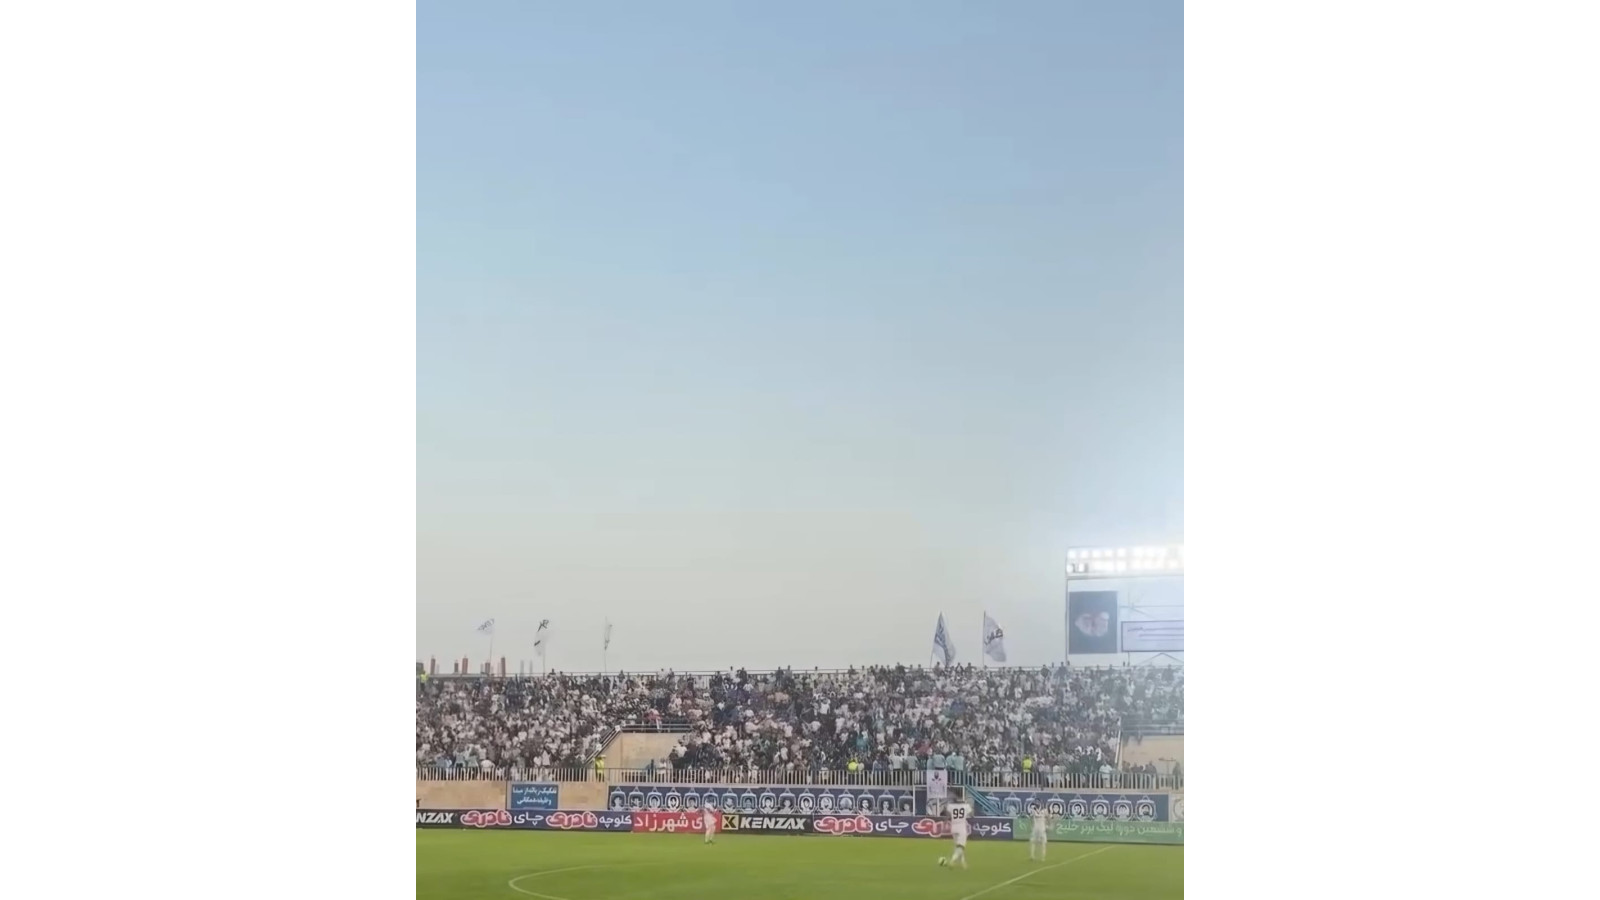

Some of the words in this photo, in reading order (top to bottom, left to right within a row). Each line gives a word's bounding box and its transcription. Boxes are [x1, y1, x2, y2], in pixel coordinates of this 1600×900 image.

[460, 809, 513, 828] نادری
[513, 812, 544, 826] چای
[546, 811, 599, 829] نادری
[953, 807, 965, 819] 99
[599, 814, 632, 829] کلوچه
[634, 812, 689, 832] شهرزاد
[740, 816, 807, 830] KENZAX
[813, 815, 874, 835] نادری
[875, 818, 909, 833] چای
[973, 822, 1012, 836] کلوچه
